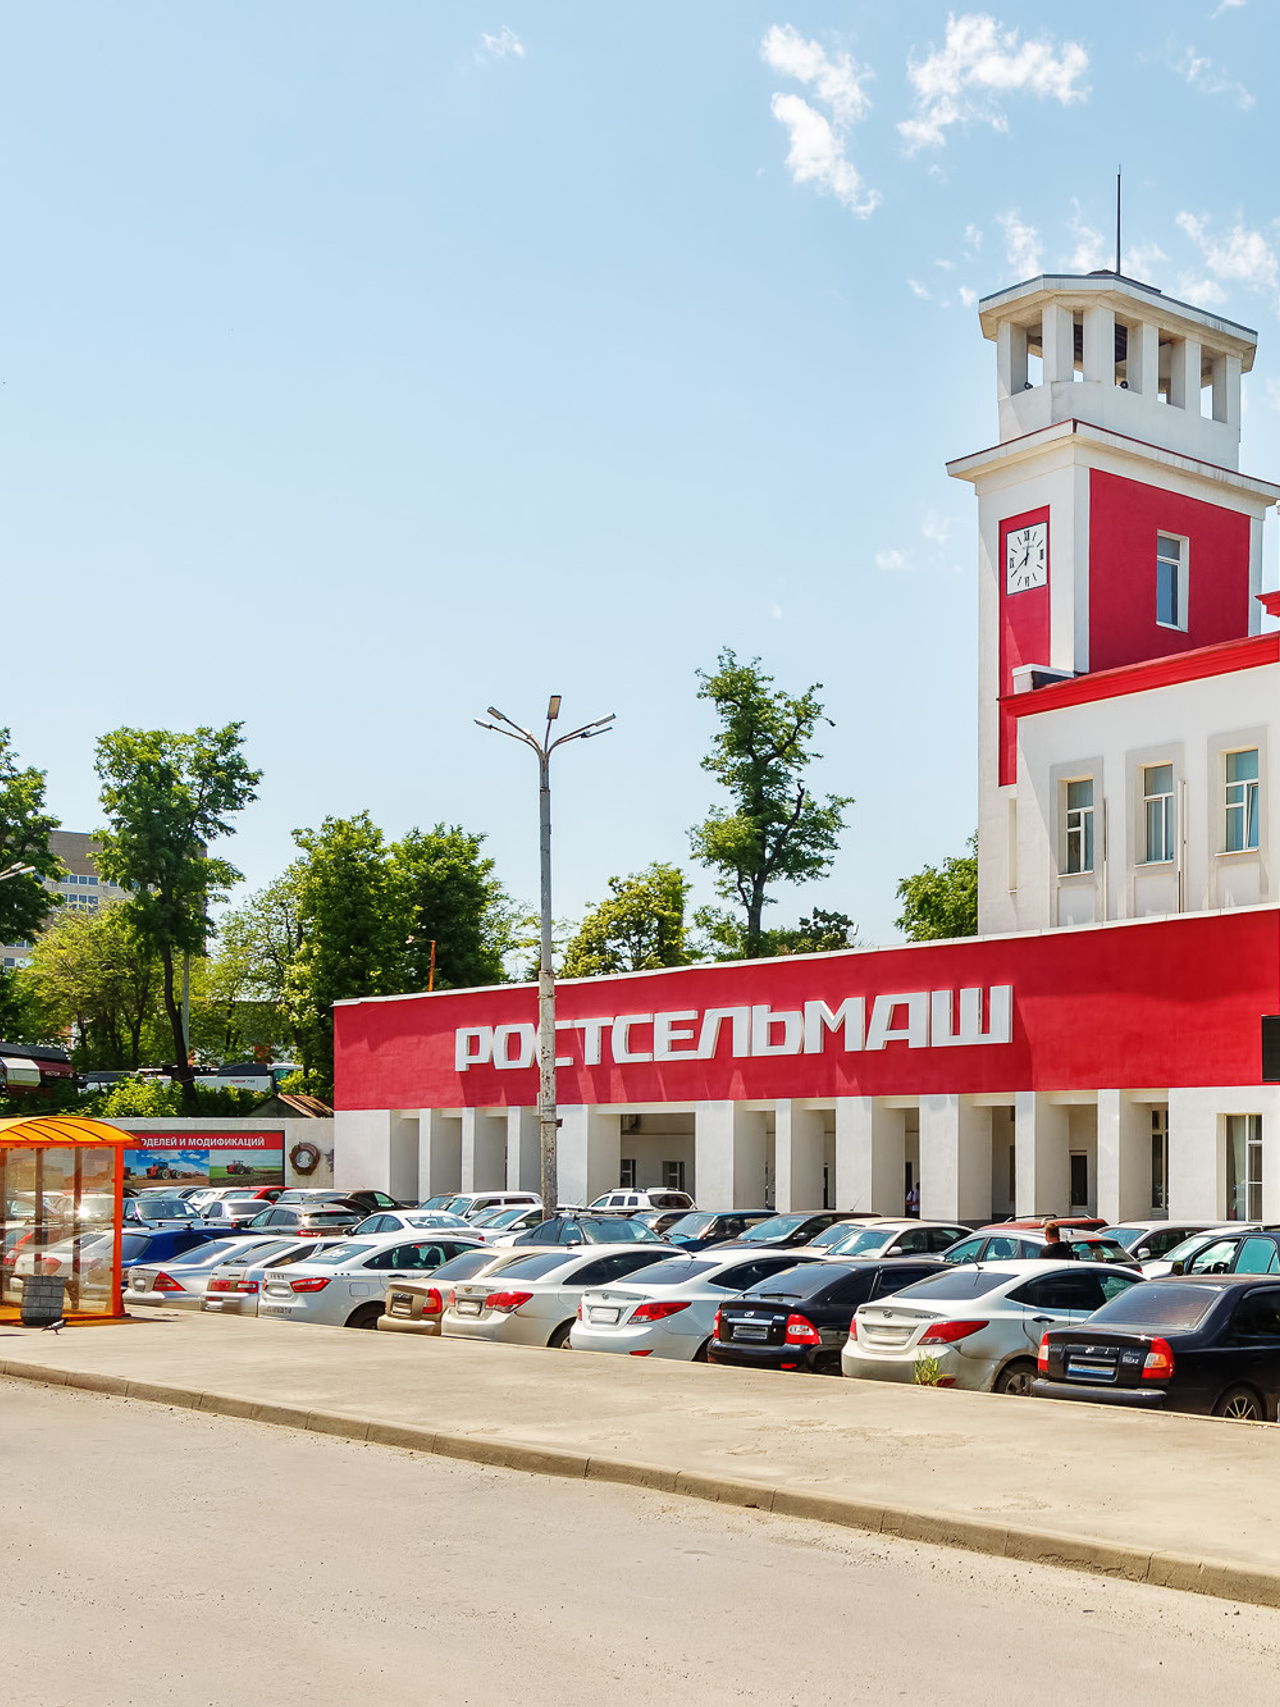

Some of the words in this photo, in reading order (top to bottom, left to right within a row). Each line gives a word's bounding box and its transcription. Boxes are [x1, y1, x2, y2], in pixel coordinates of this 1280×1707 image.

[455, 984, 1014, 1072] РОСТСЕЛЬМАШ
[141, 1136, 177, 1148] ОДЕЛЕЙ
[178, 1137, 187, 1146] И
[188, 1136, 265, 1147] МОДИФИКАЦИЙ
